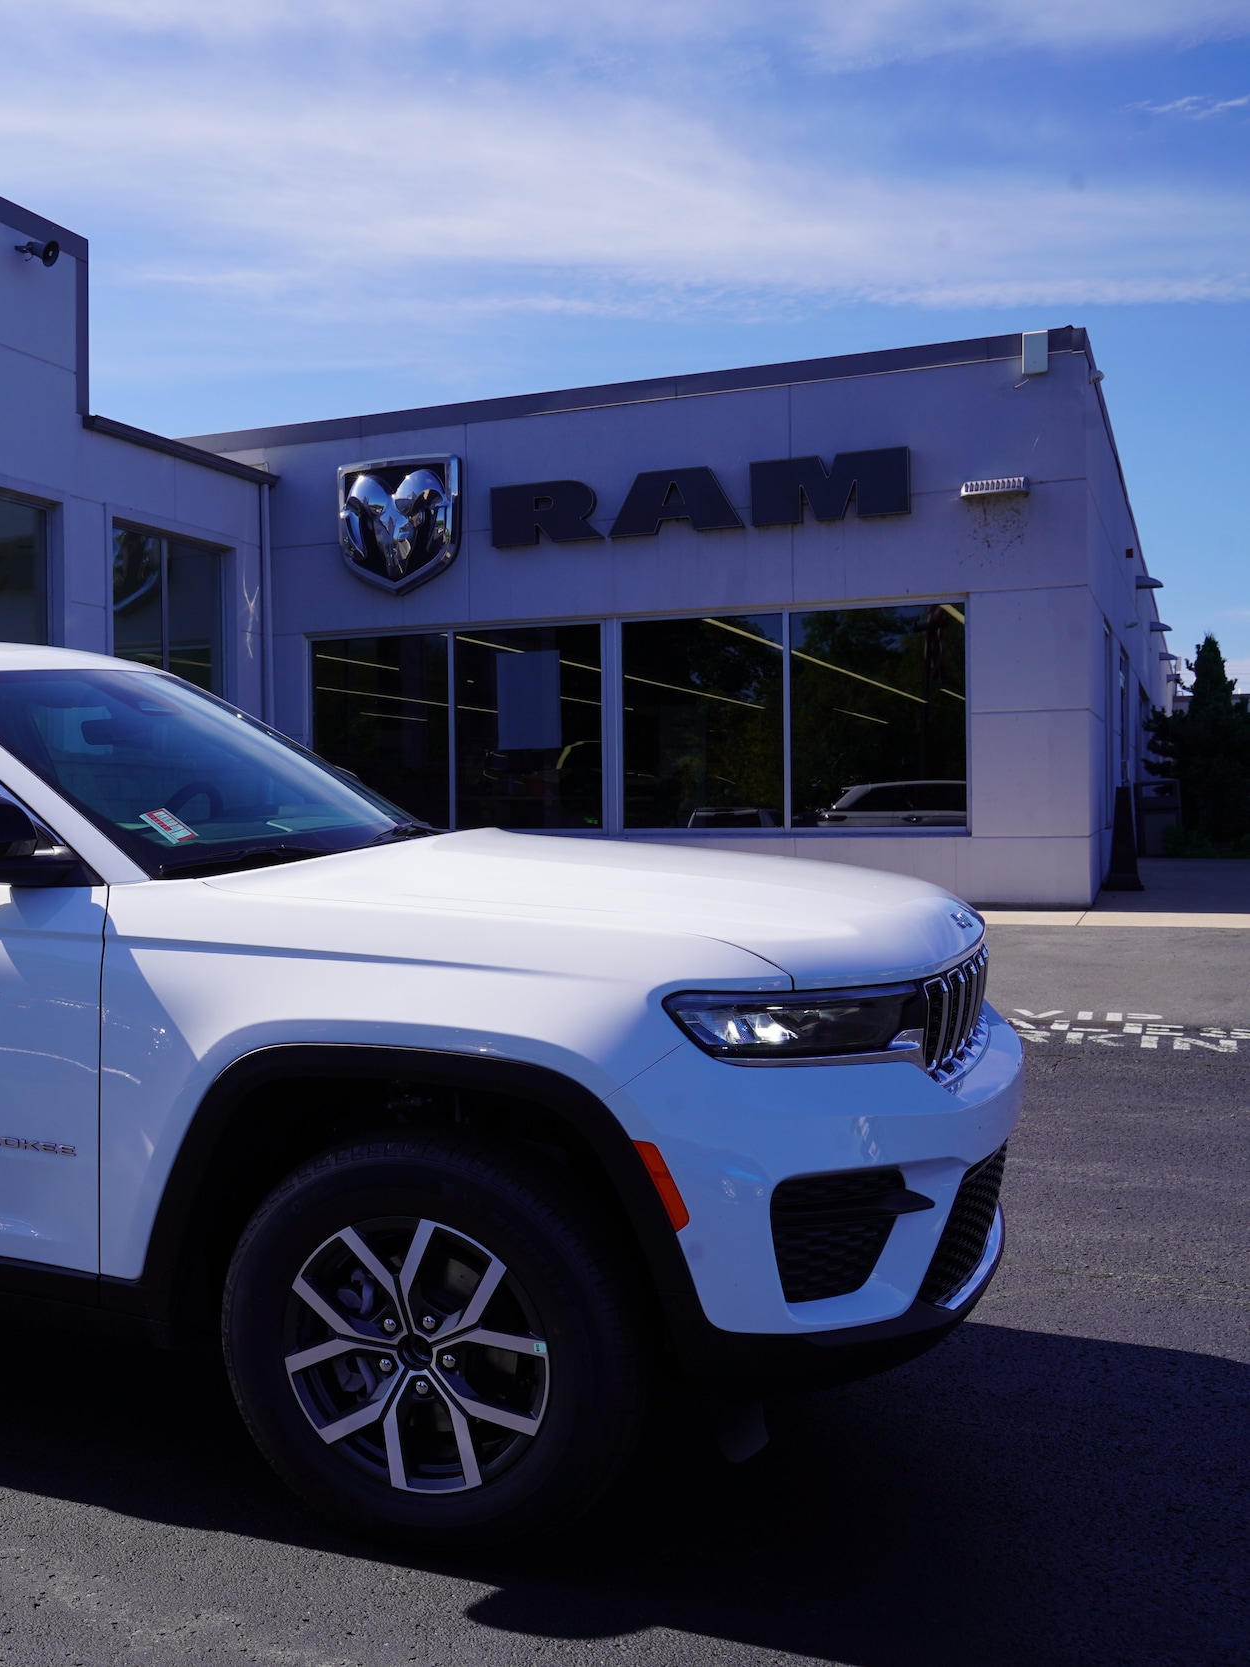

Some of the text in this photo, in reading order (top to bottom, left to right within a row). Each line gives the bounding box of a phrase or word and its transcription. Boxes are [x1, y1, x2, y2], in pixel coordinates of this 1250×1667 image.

[490, 446, 911, 549] RAM
[1013, 1008, 1163, 1022] VIP
[1016, 1029, 1239, 1053] RKIN
